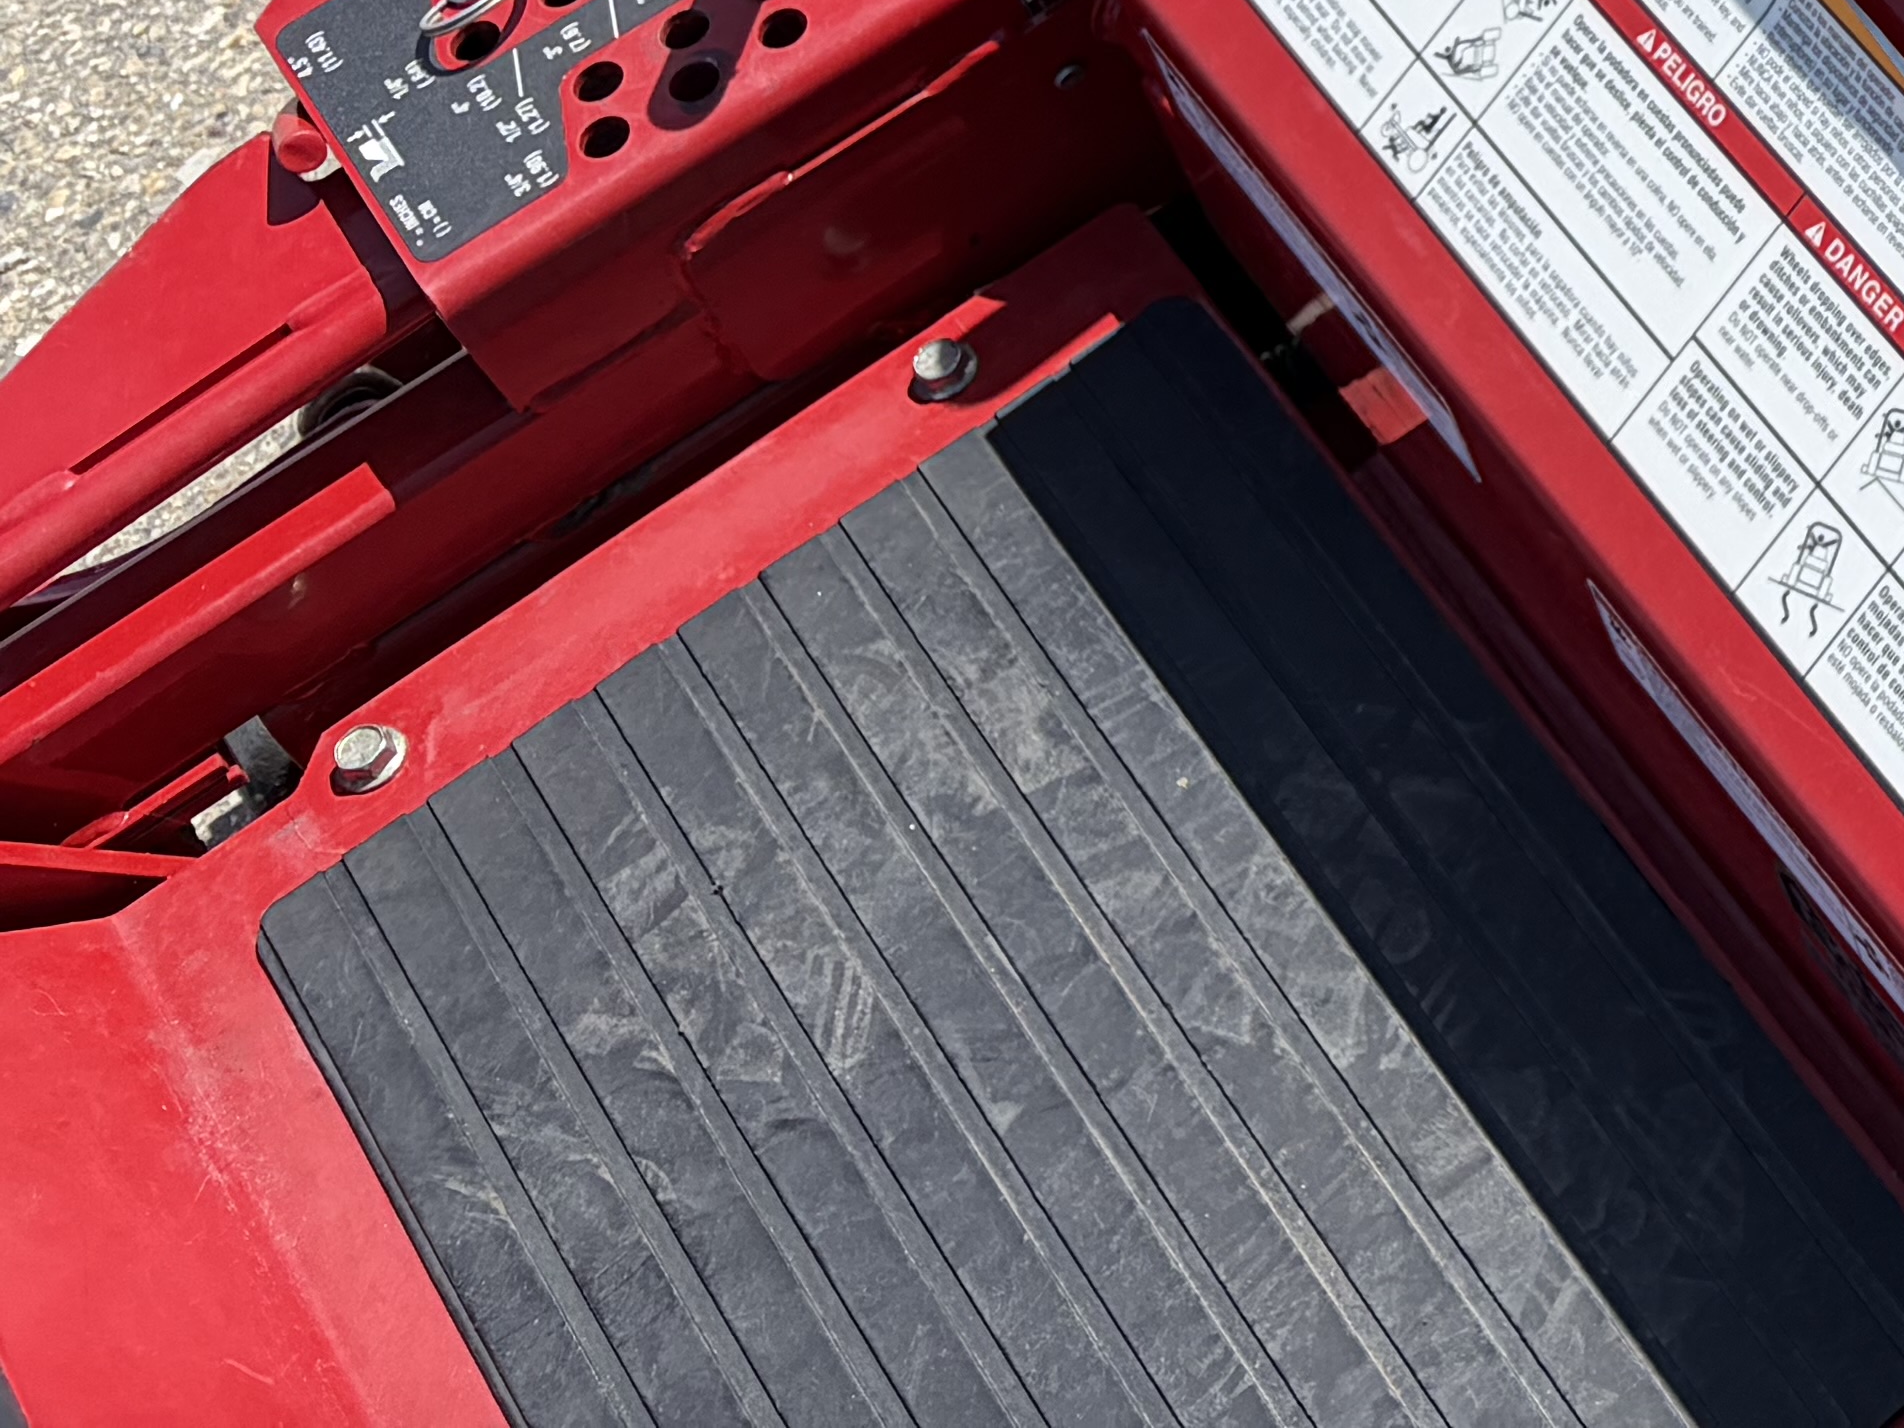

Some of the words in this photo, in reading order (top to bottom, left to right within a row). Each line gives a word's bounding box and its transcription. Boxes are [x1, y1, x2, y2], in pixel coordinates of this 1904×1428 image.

[305, 30, 343, 72] (11.43)
[559, 21, 591, 52] (7.6)
[466, 74, 502, 111] (10.2)
[514, 97, 550, 134] (1.27)
[1652, 41, 1725, 126] PELIGRO
[523, 149, 559, 187] (1.90)
[389, 194, 419, 230] INCHES
[1738, 298, 1751, 313] or
[1779, 244, 1811, 285] Wheels
[1808, 281, 1847, 327] dropping
[1844, 322, 1866, 346] over
[1863, 343, 1891, 380] edges,
[1824, 238, 1904, 331] DANGER
[1748, 285, 1776, 317] result
[1771, 310, 1783, 327] in
[1780, 323, 1813, 362] serious
[1810, 356, 1837, 394] injury,
[1837, 389, 1863, 420] death
[1758, 272, 1785, 303] cause
[1820, 344, 1848, 376] which
[1844, 373, 1867, 399] may
[1768, 260, 1800, 296] ditches
[1797, 293, 1810, 307] or
[1862, 368, 1881, 390] can
[1668, 384, 1689, 411] loss
[1685, 408, 1700, 422] of
[1694, 418, 1730, 463] steering
[1726, 457, 1747, 480] and
[1742, 476, 1776, 518] control.
[1678, 374, 1707, 409] slopes
[1704, 405, 1722, 427] can
[1719, 423, 1746, 455] cause
[1743, 452, 1774, 491] sliding
[1771, 485, 1792, 508] and
[1727, 407, 1741, 424] on
[1738, 419, 1758, 442] wet
[1753, 438, 1766, 453] or
[1763, 450, 1799, 494] slippery
[1846, 627, 1882, 666] control
[1875, 663, 1890, 681] de
[1856, 610, 1884, 645] hacer
[1881, 642, 1900, 666] que
